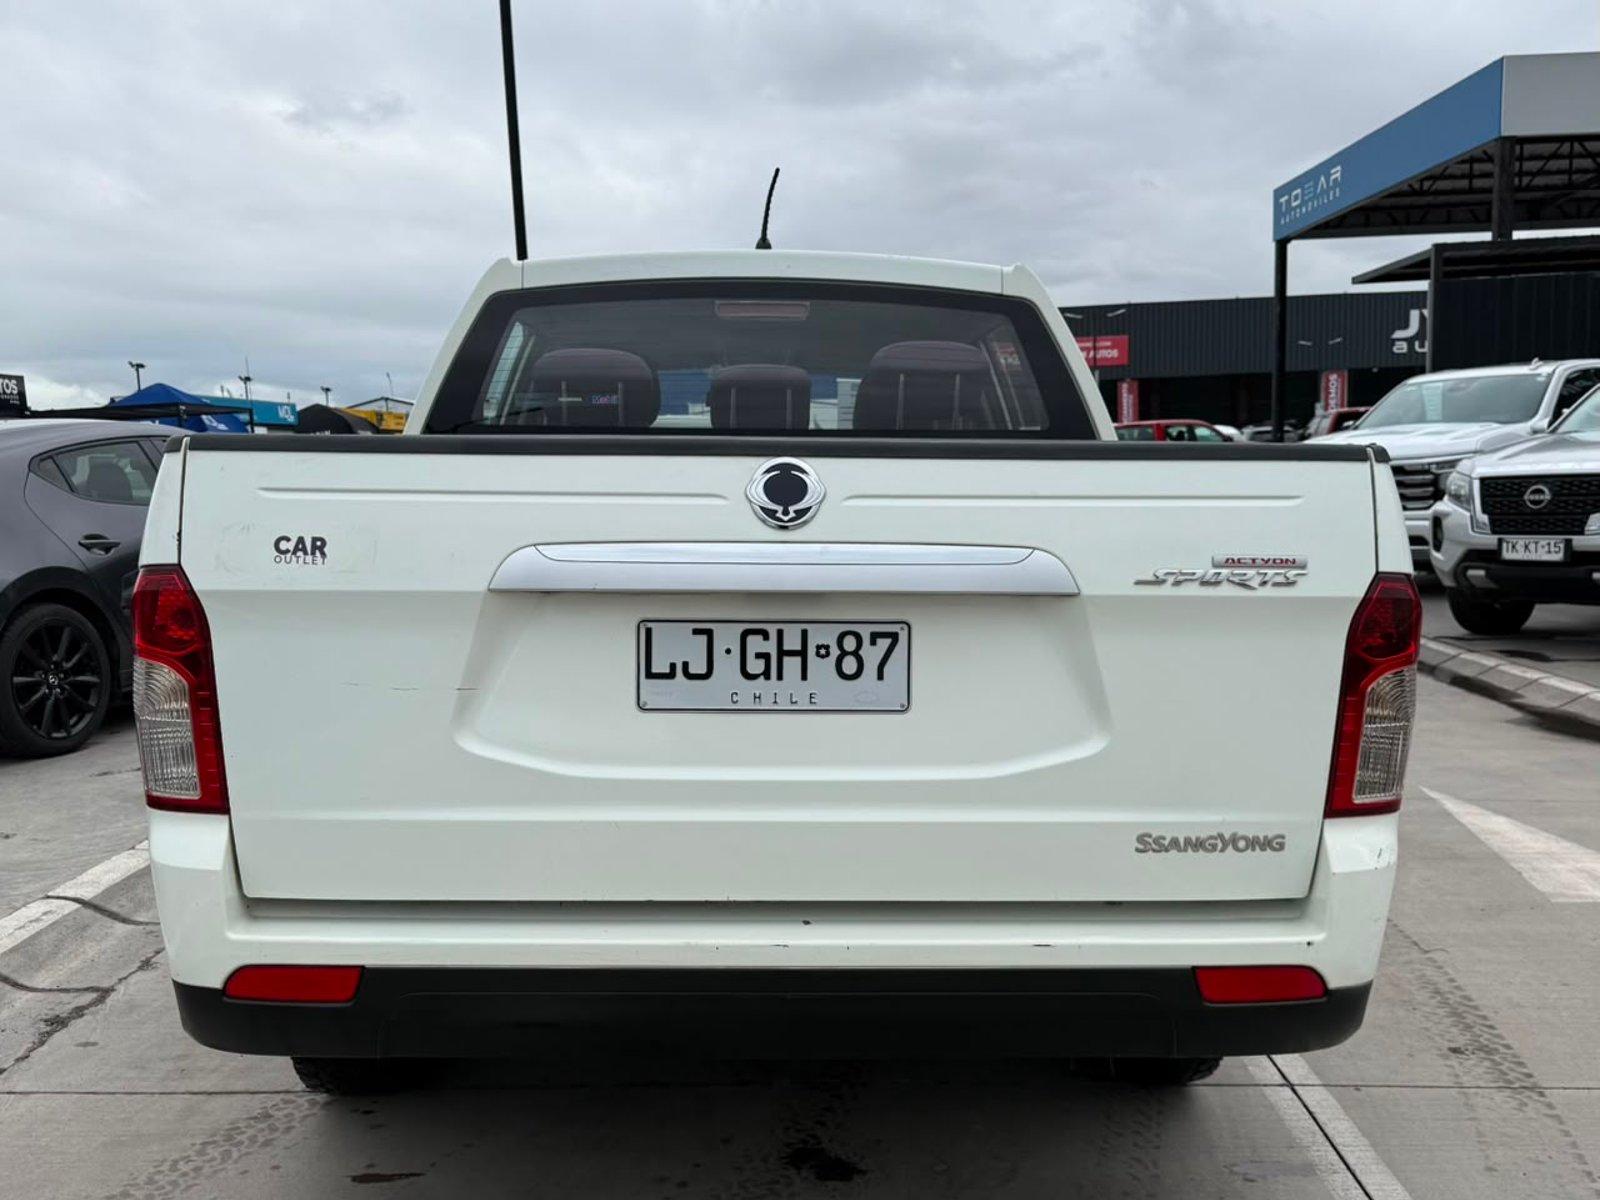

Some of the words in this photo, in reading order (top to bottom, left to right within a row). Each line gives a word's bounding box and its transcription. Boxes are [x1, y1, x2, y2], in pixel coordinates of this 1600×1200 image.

[274, 535, 327, 557] CAR
[274, 555, 326, 566] OUTLET
[1224, 557, 1297, 565] ACTYON
[1133, 569, 1309, 590] SPORTS
[730, 692, 818, 705] CHILE
